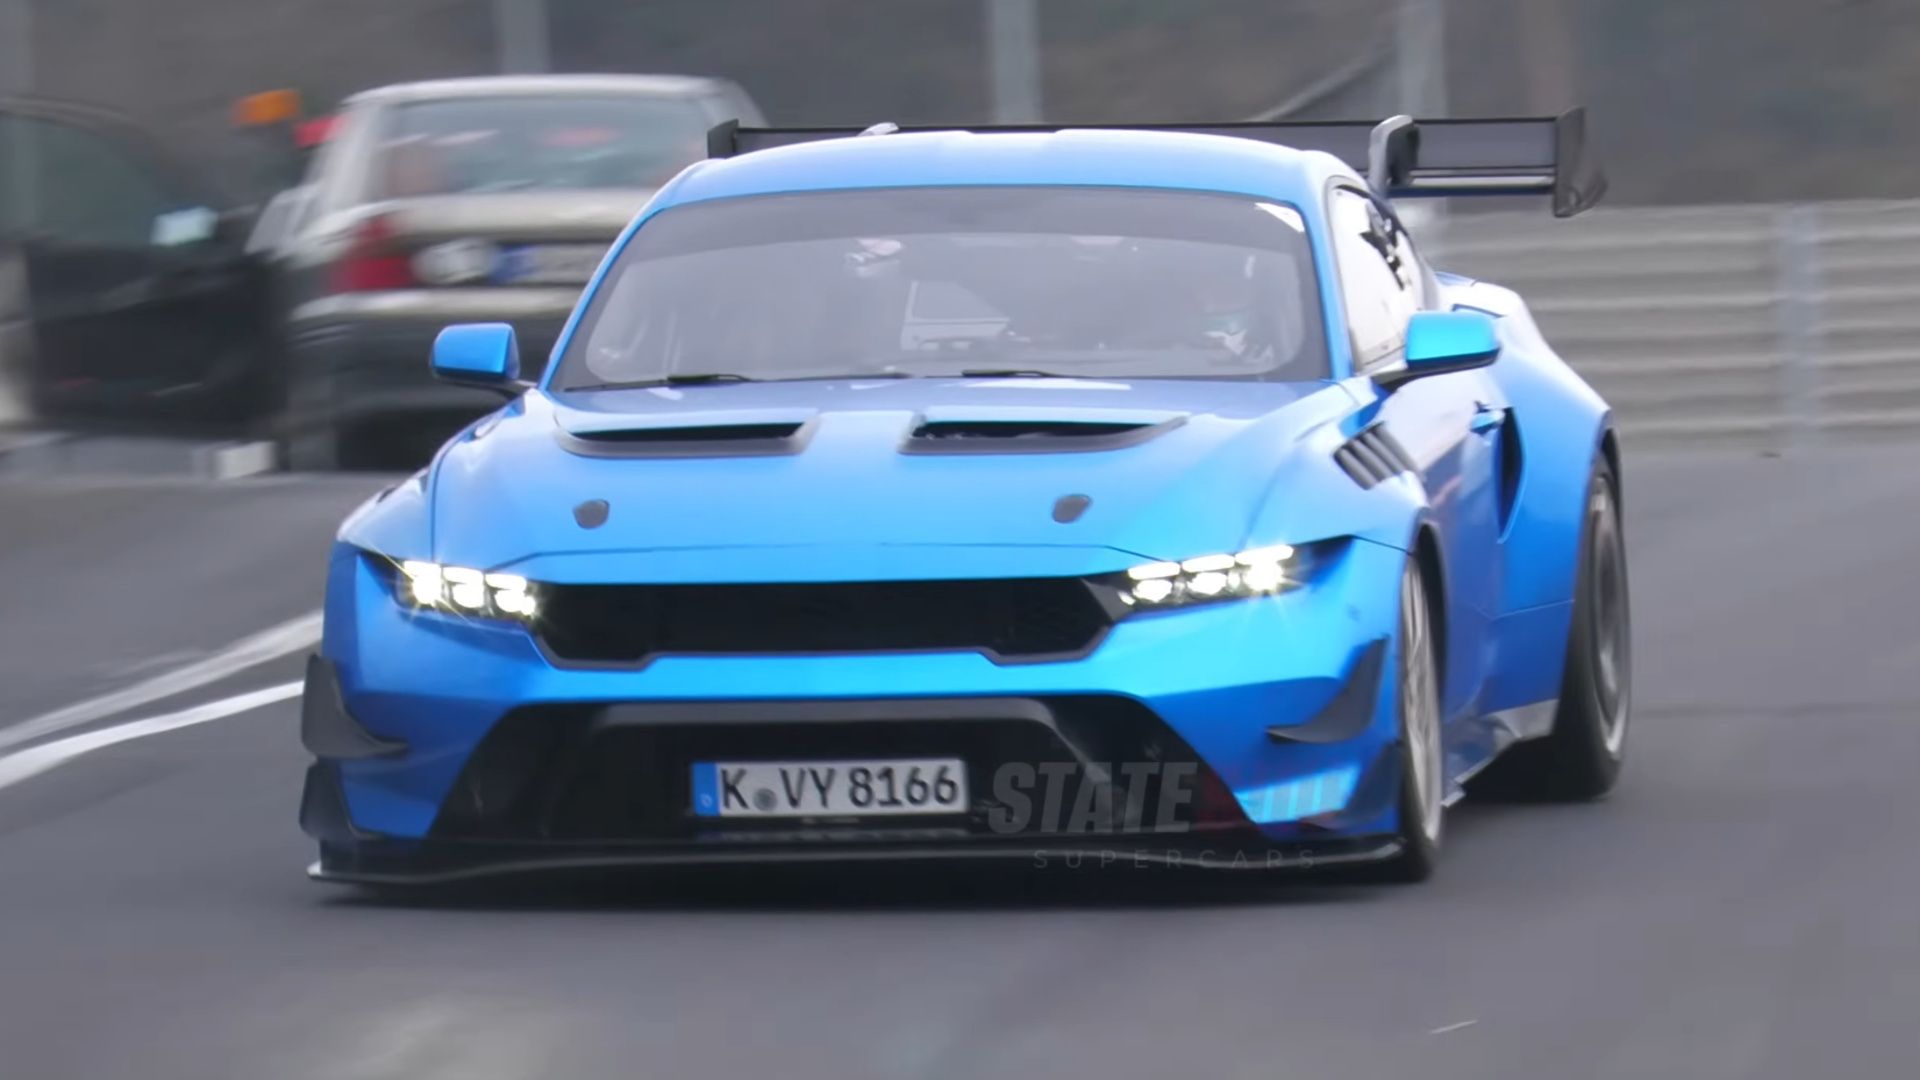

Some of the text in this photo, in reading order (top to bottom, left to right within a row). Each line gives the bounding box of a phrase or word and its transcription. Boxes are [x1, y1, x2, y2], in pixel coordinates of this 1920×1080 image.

[720, 765, 960, 809] K VY 8166
